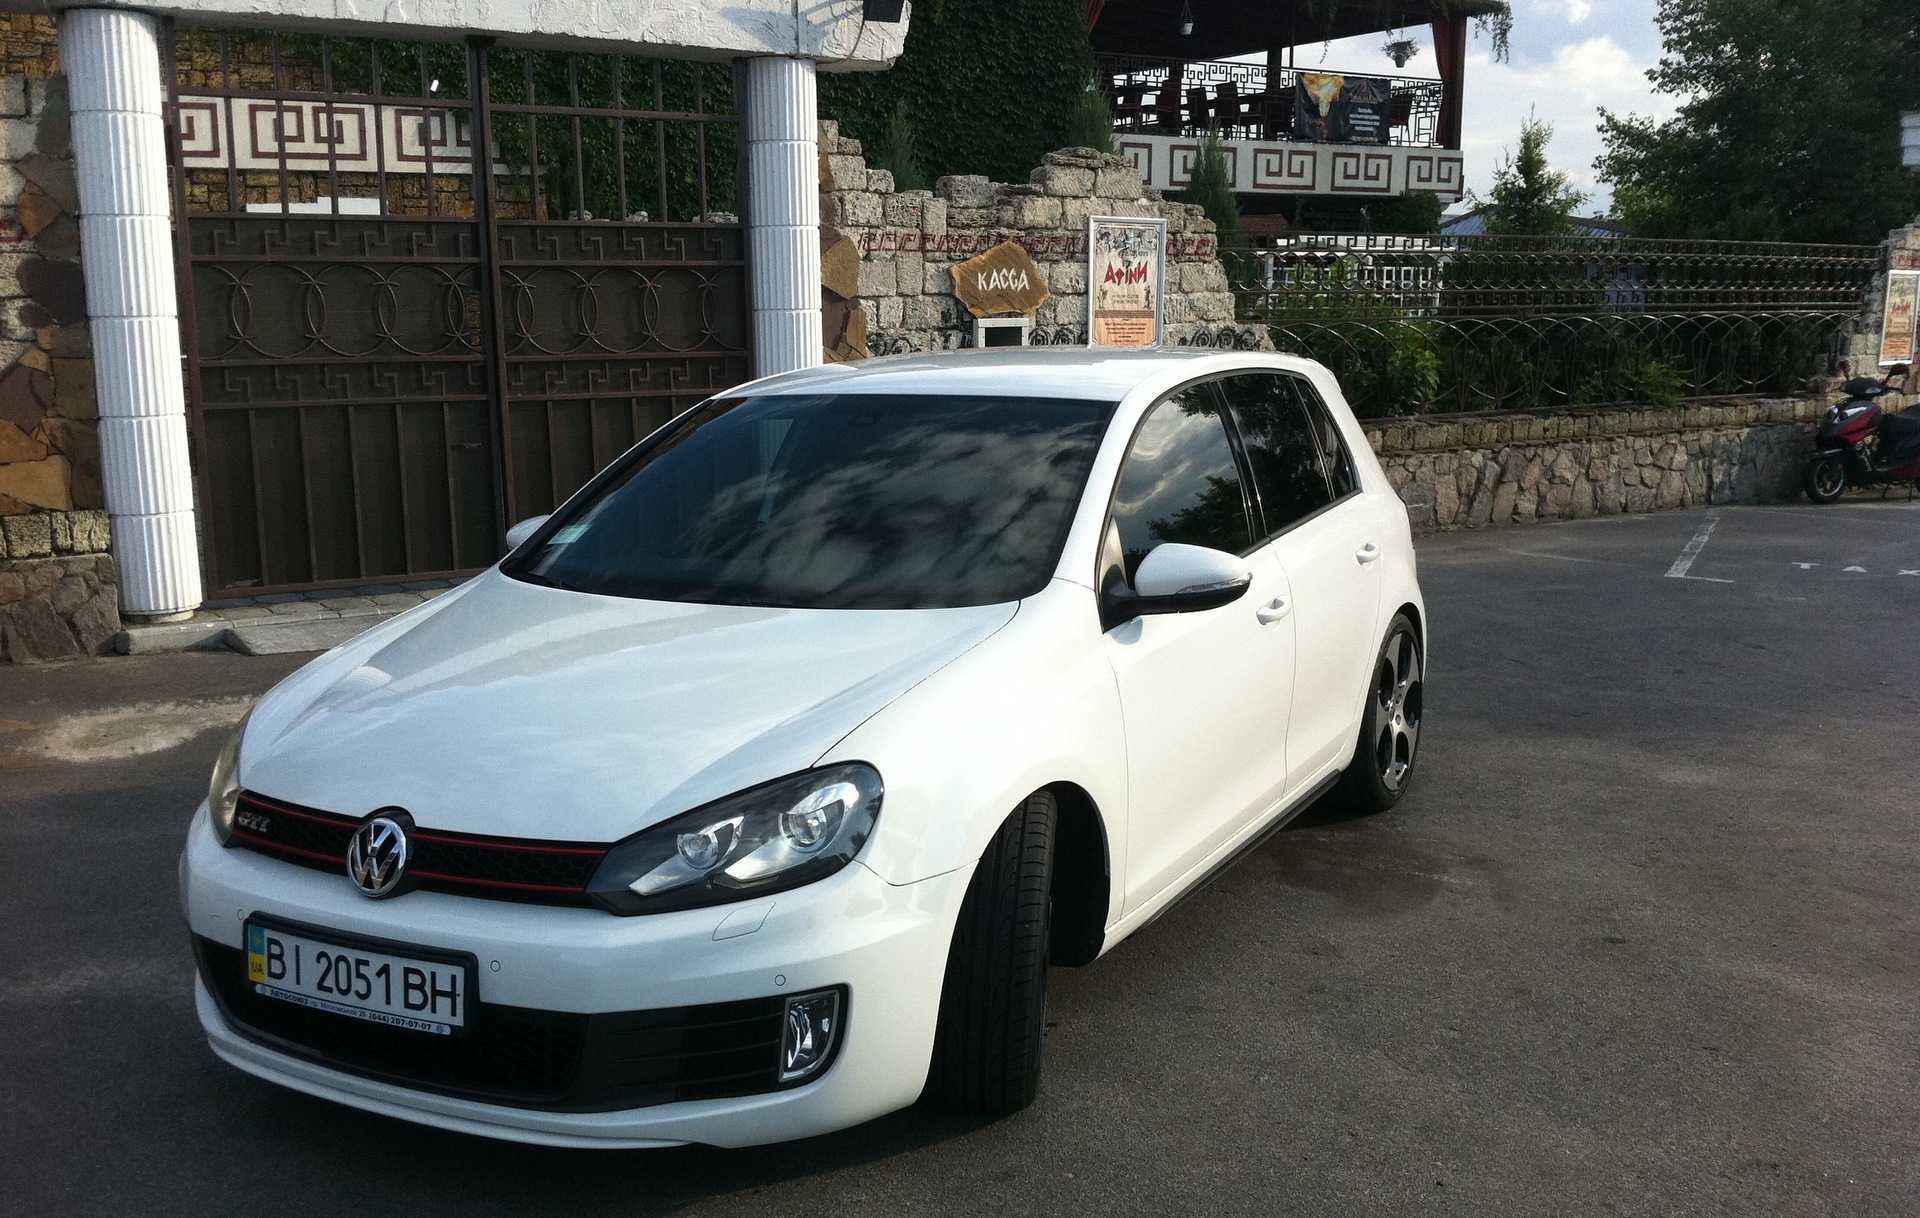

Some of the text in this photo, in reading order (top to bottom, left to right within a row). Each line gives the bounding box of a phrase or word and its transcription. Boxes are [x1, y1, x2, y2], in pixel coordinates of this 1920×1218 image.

[978, 267, 1030, 292] КАССА
[238, 811, 271, 833] GTI
[251, 961, 263, 974] UA
[267, 937, 457, 1017] BI 2051 BH
[270, 989, 308, 1006] АВТОСОЮЗ
[369, 1011, 390, 1024] (044)
[391, 1013, 432, 1031] 207-07-07
